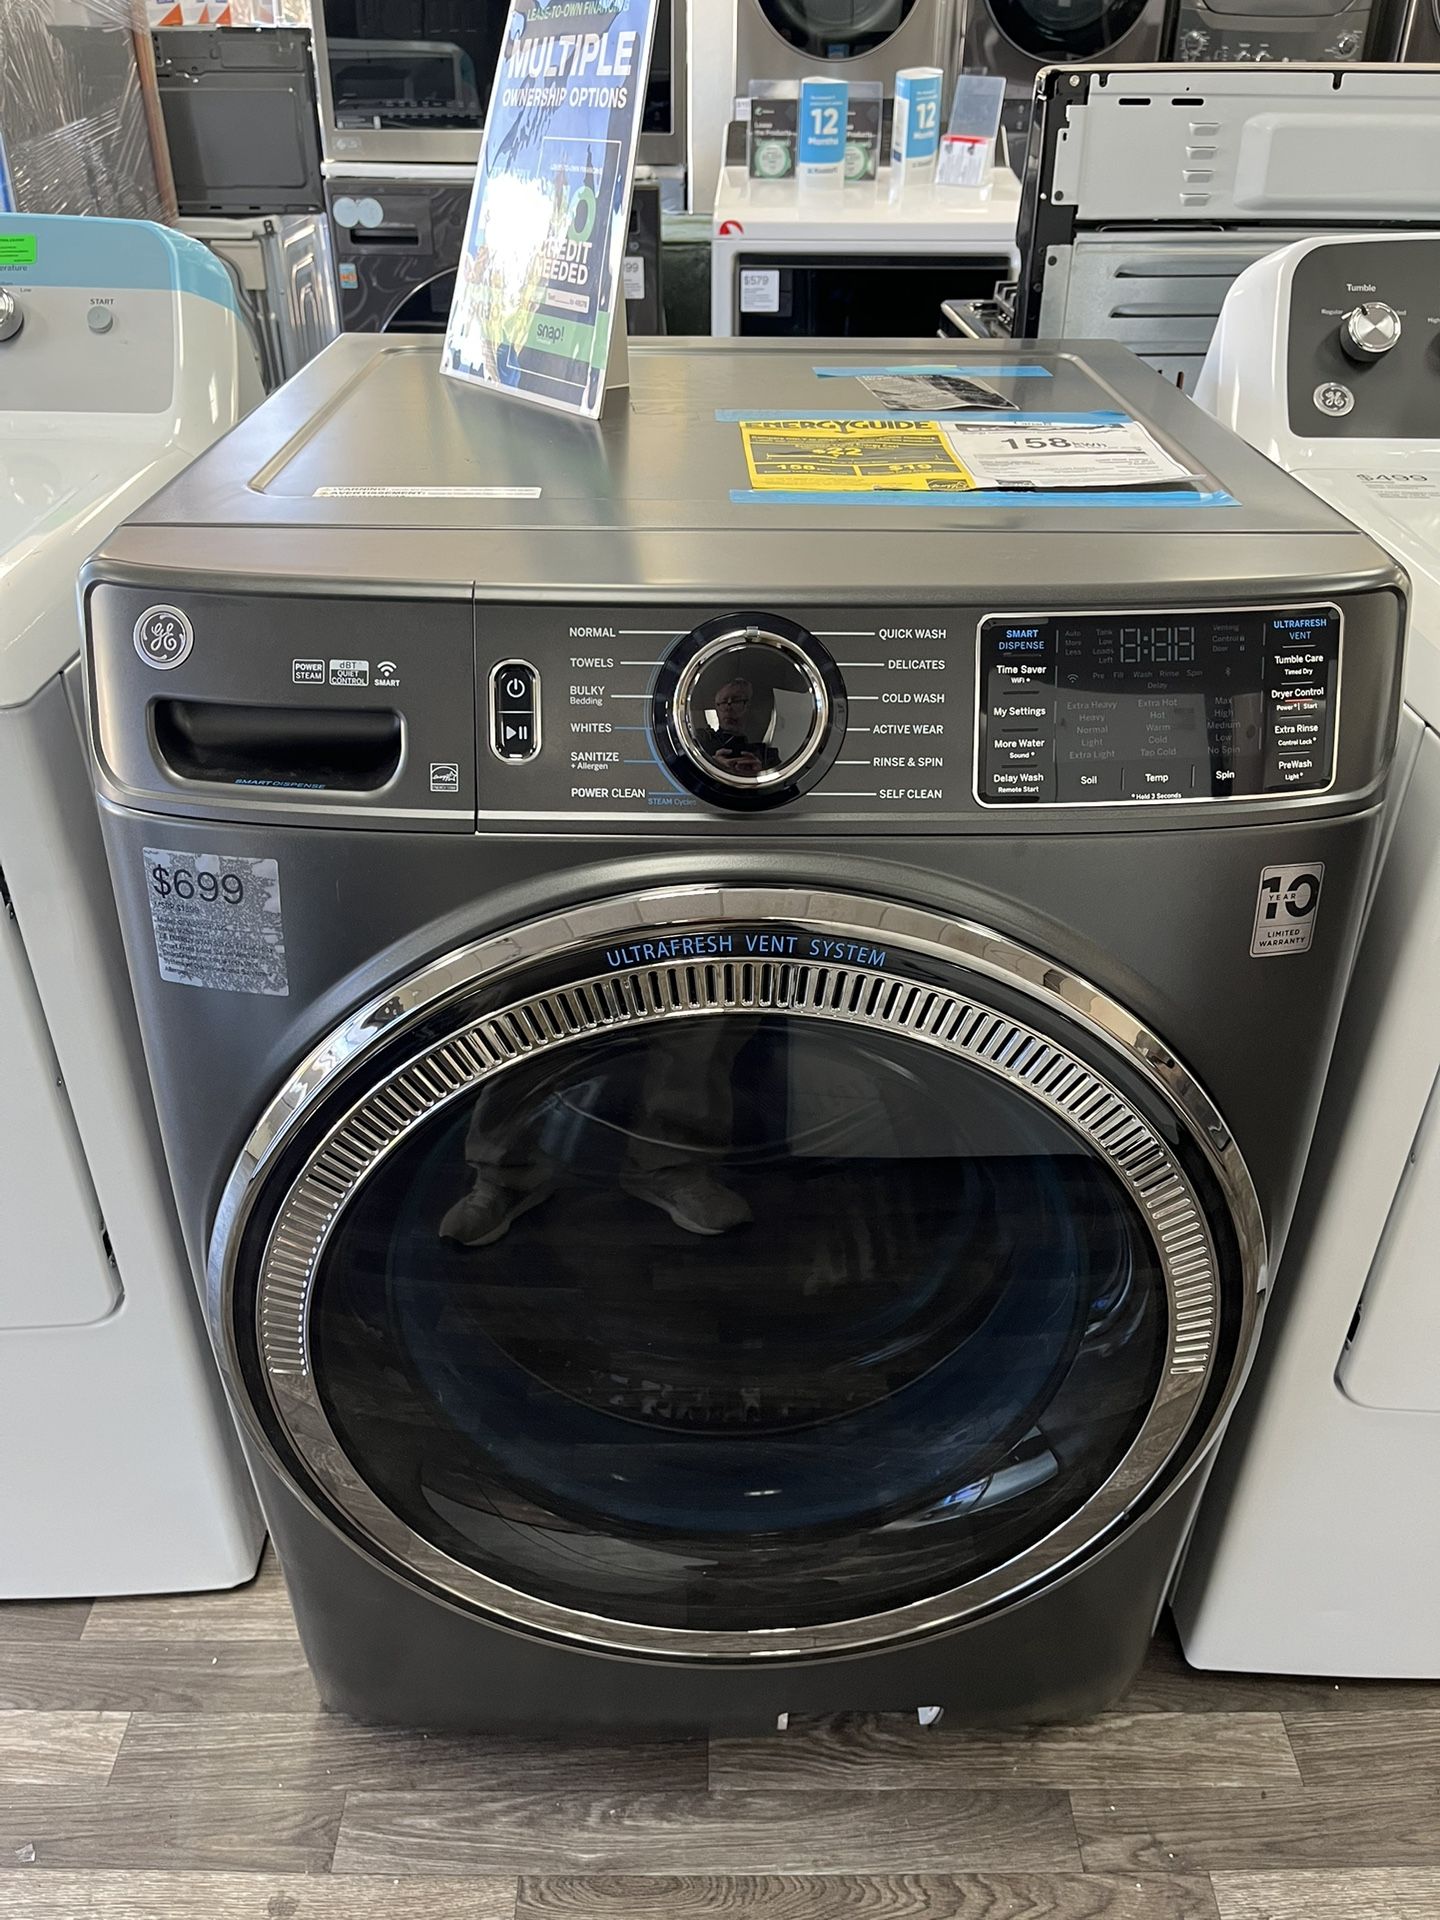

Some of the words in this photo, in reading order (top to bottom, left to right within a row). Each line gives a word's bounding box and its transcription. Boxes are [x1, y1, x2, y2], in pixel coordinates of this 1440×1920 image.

[508, 31, 637, 78] MULTIPLE
[503, 88, 566, 108] OWNERSHIP
[570, 87, 627, 108] OPTIONS
[917, 101, 937, 129] 12
[811, 107, 839, 135] 12
[1346, 284, 1377, 292] Tumble
[537, 323, 565, 343] snap!
[1000, 437, 1073, 450] 158
[1274, 619, 1327, 628] ULTRAFRESH
[569, 627, 616, 638] NORMAL
[879, 629, 913, 640] QUICK
[915, 629, 947, 639] WASH
[1006, 630, 1039, 638] SMART
[1289, 631, 1312, 640] VENT
[998, 641, 1045, 649] DISPENSE
[570, 658, 613, 668] TOWELS
[1275, 655, 1303, 665] Tumble
[1305, 655, 1324, 663] Care
[296, 663, 322, 671] POWER
[888, 660, 945, 670] DELICATES
[996, 665, 1018, 674] Time
[1021, 665, 1047, 674] Saver
[296, 672, 321, 680] STEAM
[337, 669, 358, 677] QUIET
[332, 677, 365, 685] CONTROL
[374, 679, 400, 687] SMART
[570, 686, 605, 695] BULKY
[1271, 690, 1293, 700] Dryer
[1294, 687, 1324, 697] Control
[570, 697, 603, 705] Bedding
[882, 693, 911, 703] COLD
[913, 693, 945, 703] WASH
[1067, 702, 1089, 710] Extra
[1138, 699, 1159, 707] Extra
[993, 707, 1007, 717] My
[1009, 707, 1046, 716] Settings
[570, 723, 612, 733] WHITES
[873, 724, 910, 734] ACTIVE
[913, 724, 944, 734] WEAR
[1207, 721, 1241, 729] Medium
[1275, 726, 1295, 734] Extra
[994, 740, 1017, 748] More
[1081, 739, 1103, 747] Light
[1149, 736, 1167, 744] Cold
[1069, 751, 1091, 759] Extra
[1094, 750, 1115, 759] Light
[1208, 746, 1220, 754] No
[1222, 746, 1240, 754] Spin
[570, 752, 619, 762] SANITIZE
[577, 762, 608, 771] Allergen
[873, 757, 905, 767] RINSE
[907, 757, 915, 767] &
[918, 757, 943, 767] SPIN
[1278, 760, 1312, 769] PreWash
[993, 774, 1018, 783] Delay
[1020, 774, 1044, 782] Wash
[1145, 773, 1169, 783] Temp
[1216, 770, 1235, 779] Spin
[1081, 776, 1097, 784] Soil
[571, 788, 609, 798] POWER
[612, 788, 645, 798] CLEAN
[879, 789, 904, 798] SELF
[906, 789, 943, 798] CLEAN
[152, 864, 244, 905] $699
[1262, 873, 1320, 920] 10
[1269, 893, 1296, 901] YEAR
[1267, 929, 1300, 938] LIMITED
[1259, 936, 1306, 947] WARRANTY
[606, 936, 733, 967] ULTRAFRESH
[745, 935, 798, 953] VENT
[809, 938, 887, 967] SYSTEM
